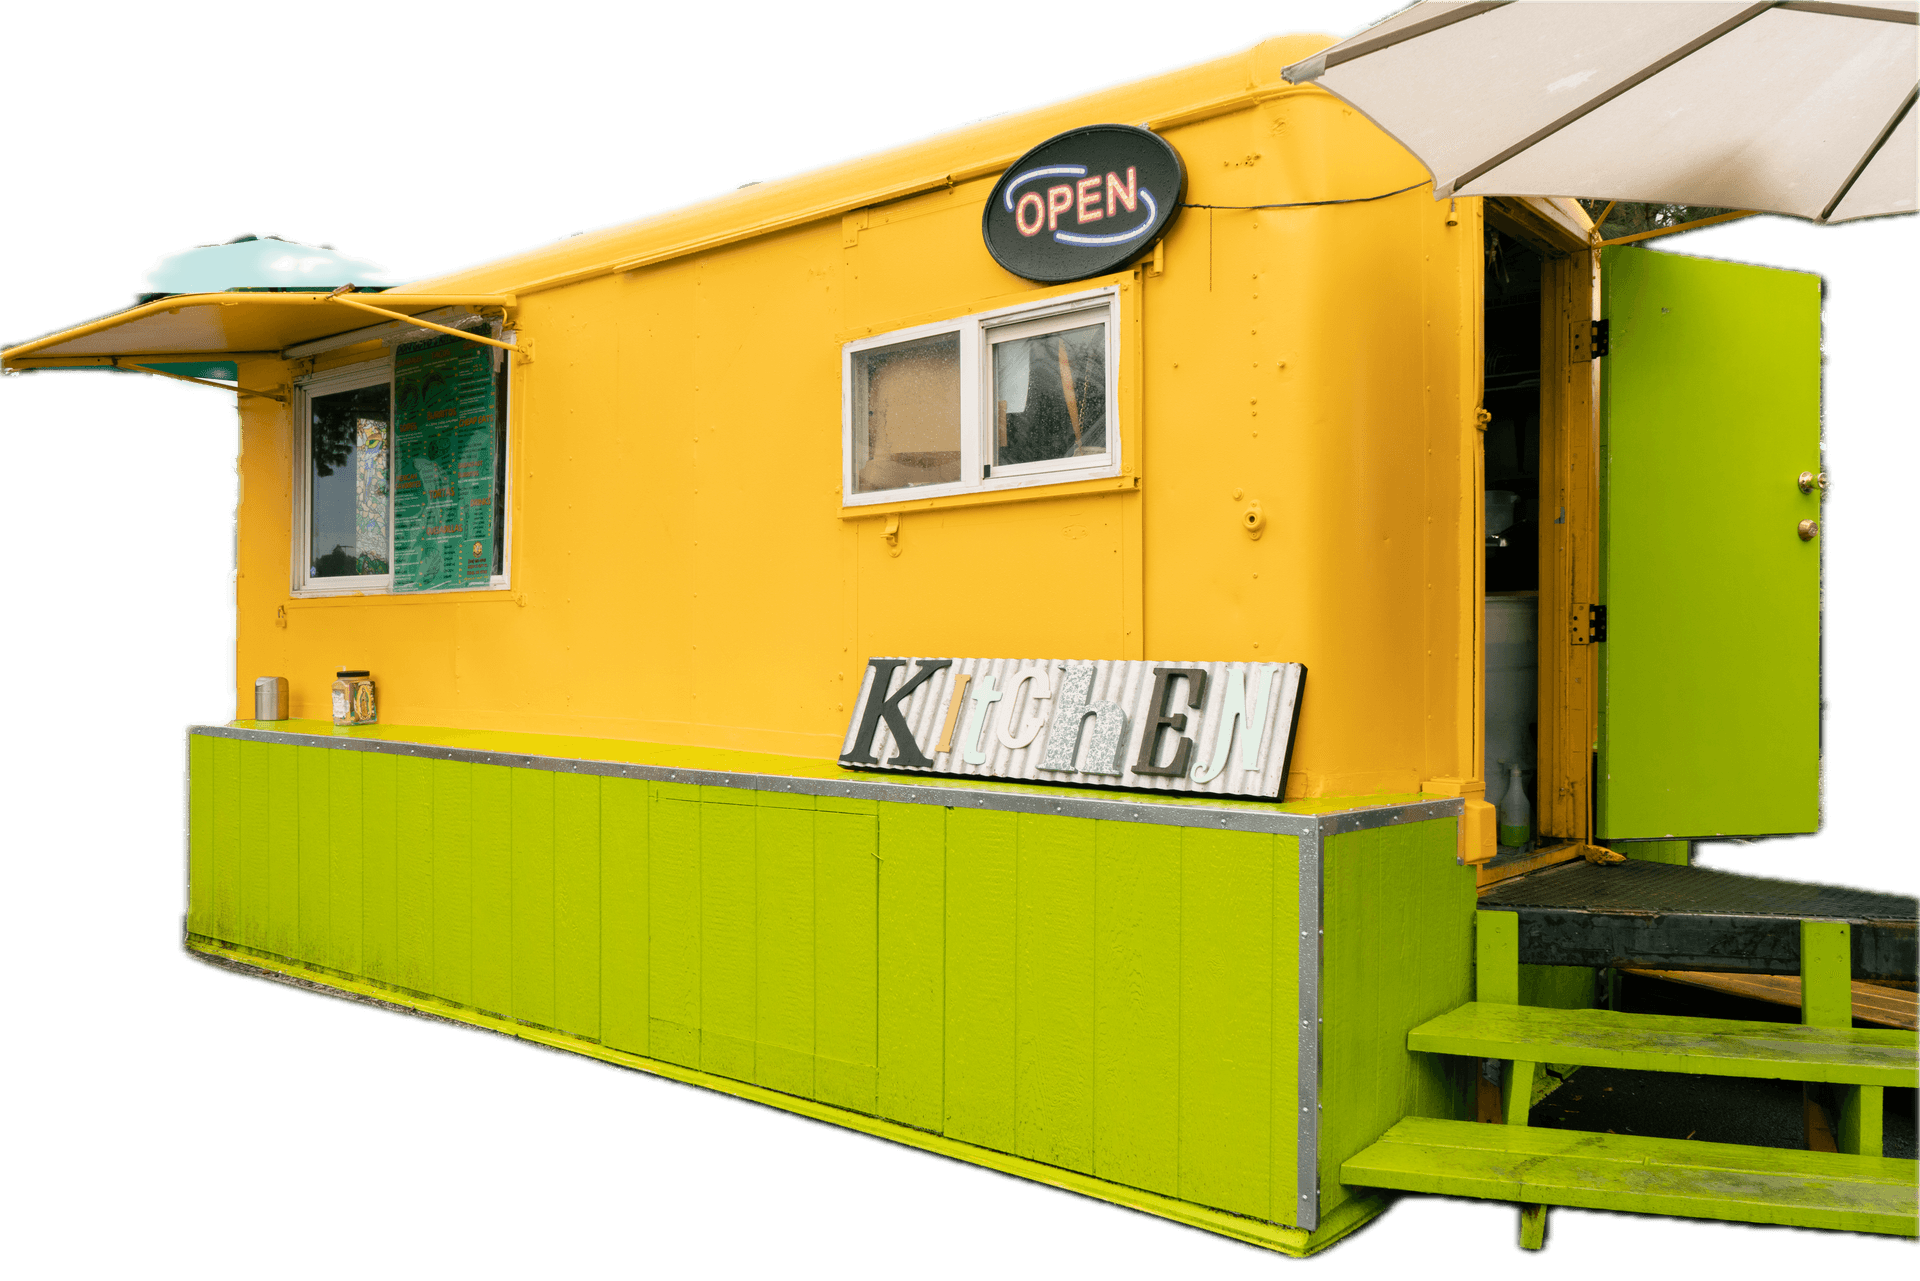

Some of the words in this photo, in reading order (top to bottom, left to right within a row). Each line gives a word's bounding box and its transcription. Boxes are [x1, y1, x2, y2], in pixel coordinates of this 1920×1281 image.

[1015, 166, 1137, 237] OPEN
[426, 407, 457, 421] BURRITOS
[399, 422, 418, 433] SOPES
[459, 416, 478, 428] CHEAP
[478, 414, 494, 425] EATS
[395, 473, 418, 482] MEXICAN
[395, 481, 422, 490] FAVORITES
[428, 486, 455, 500] TORTAS
[470, 497, 492, 507] DRINKS
[426, 523, 464, 536] QUESADILLAS
